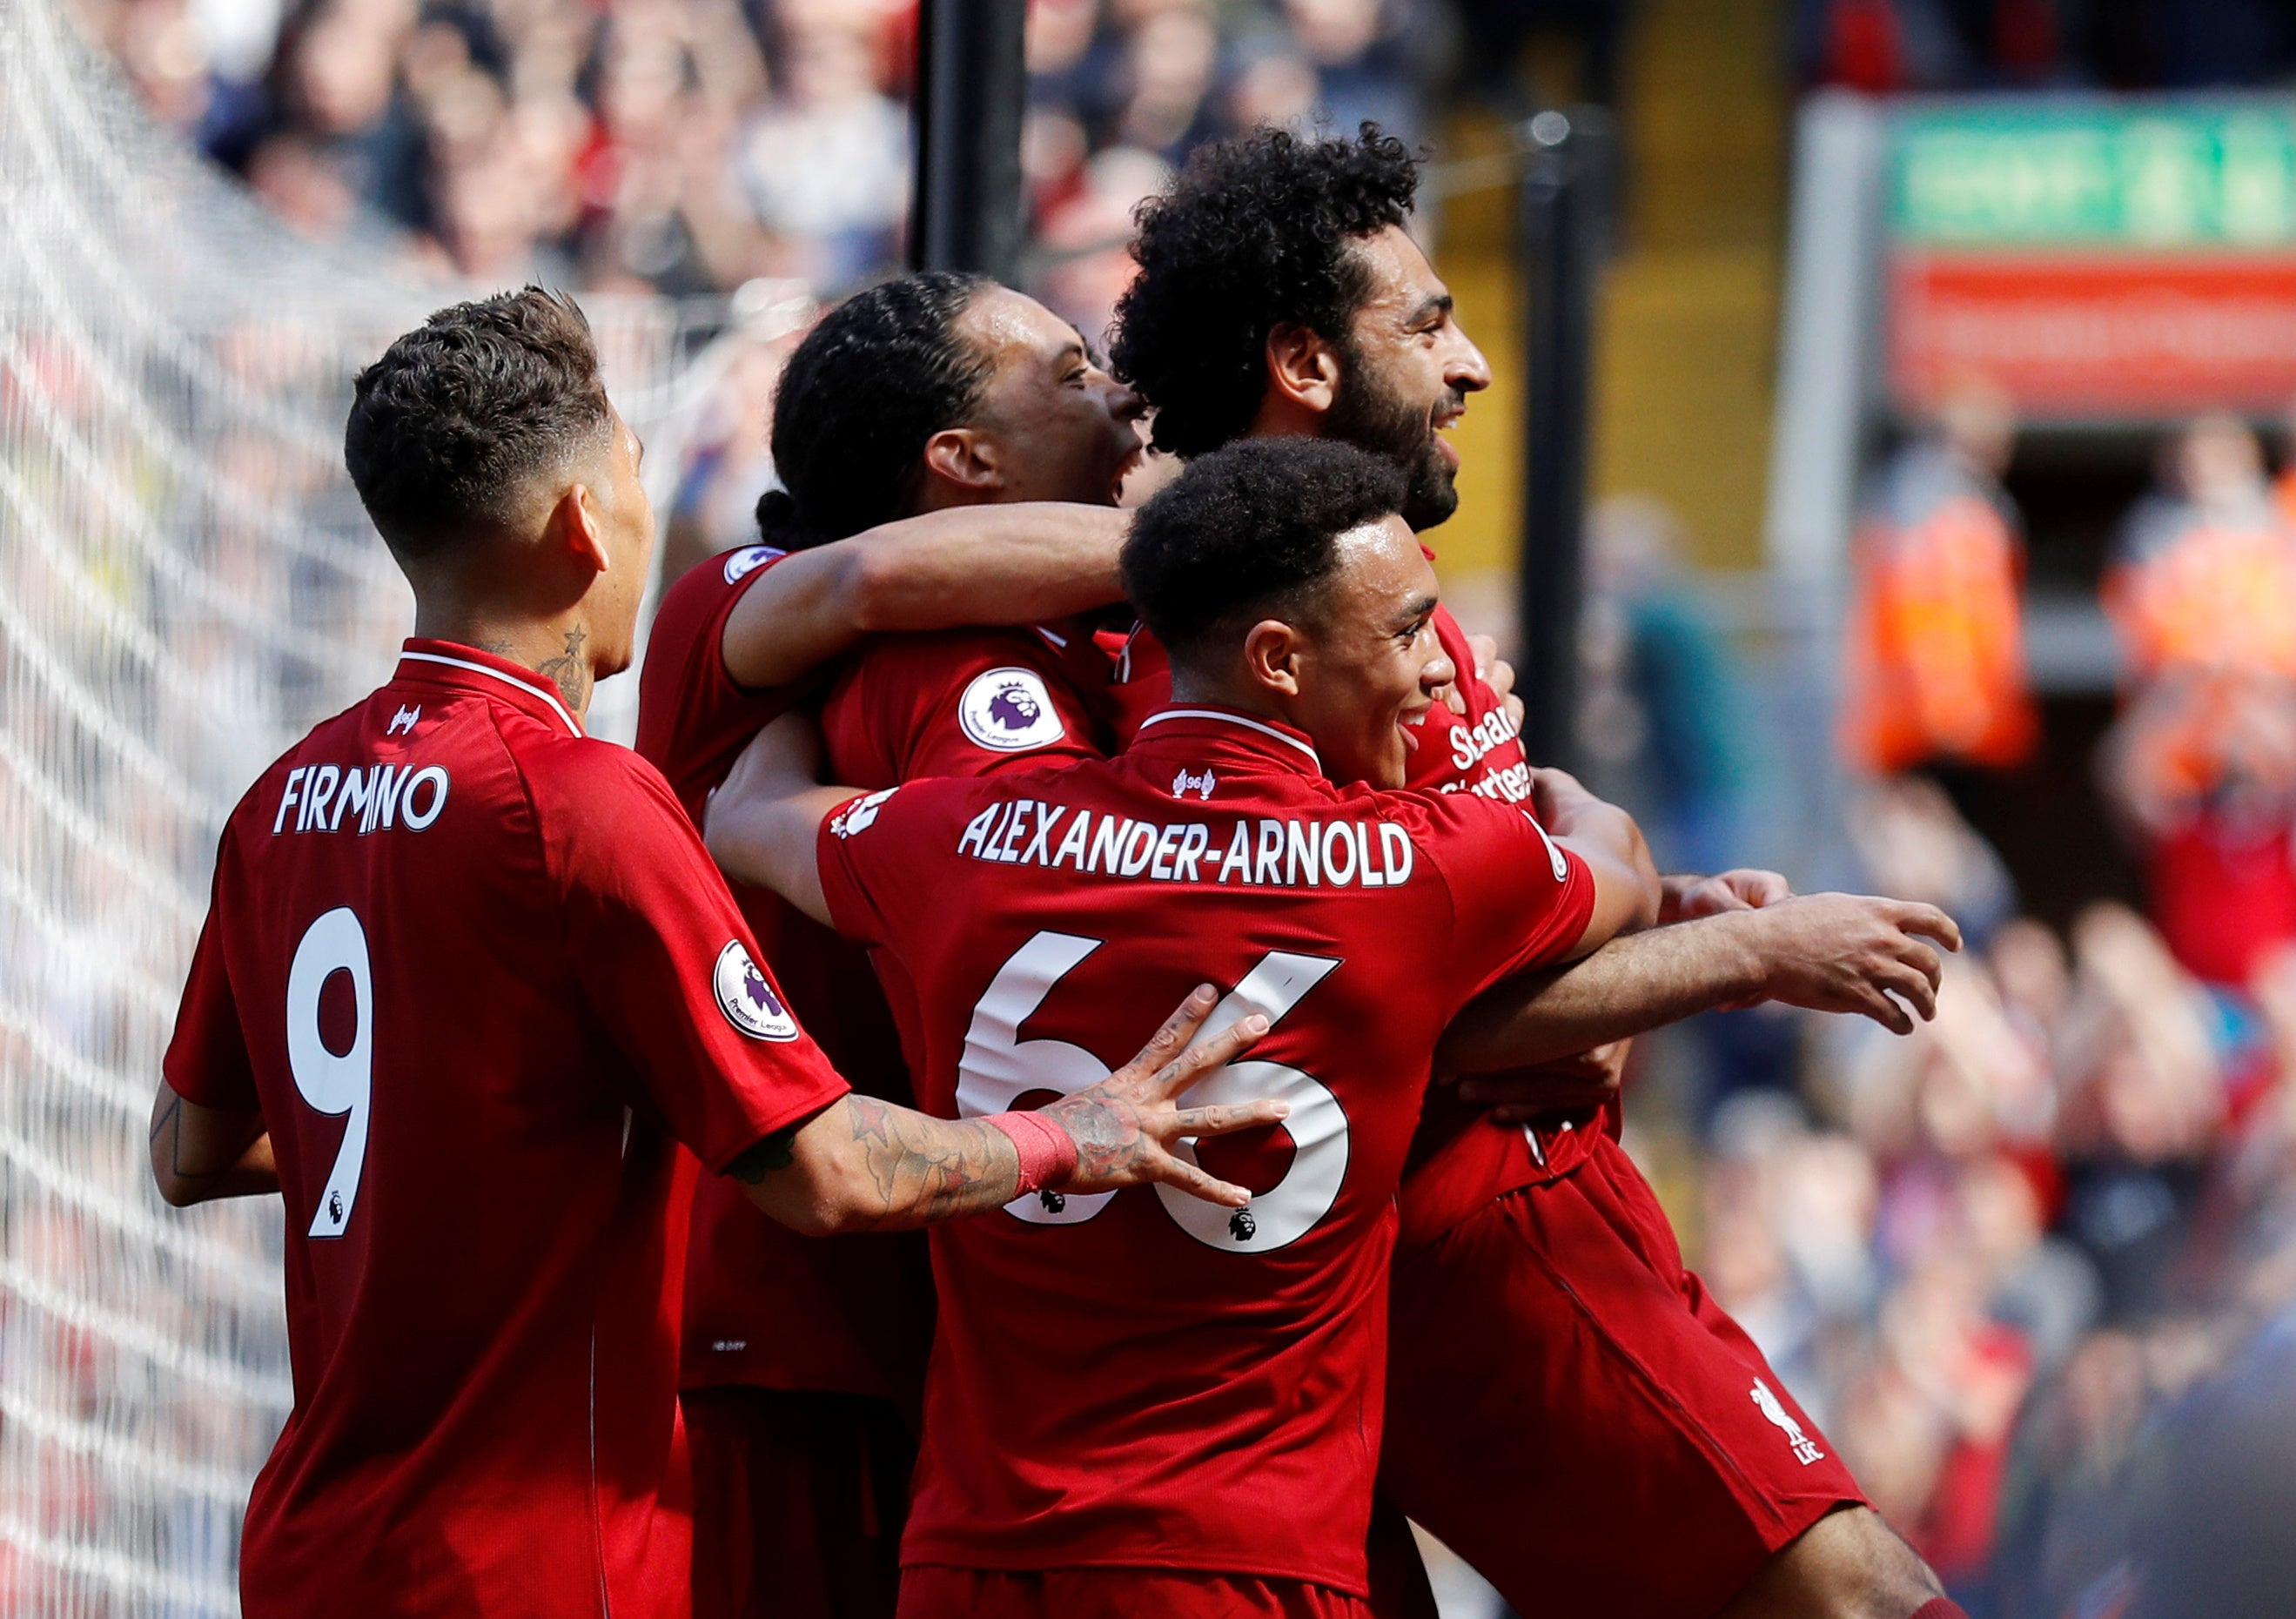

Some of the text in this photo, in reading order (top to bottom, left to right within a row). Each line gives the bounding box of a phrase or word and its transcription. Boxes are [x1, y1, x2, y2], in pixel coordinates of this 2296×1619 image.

[1186, 776, 1202, 789] 96
[957, 799, 1413, 888] ALEXANDER-ARNOLD
[730, 998, 758, 1024] Premier
[286, 905, 374, 1238] 9
[955, 930, 1350, 1254] 66
[1793, 1441, 1824, 1465] LFC
